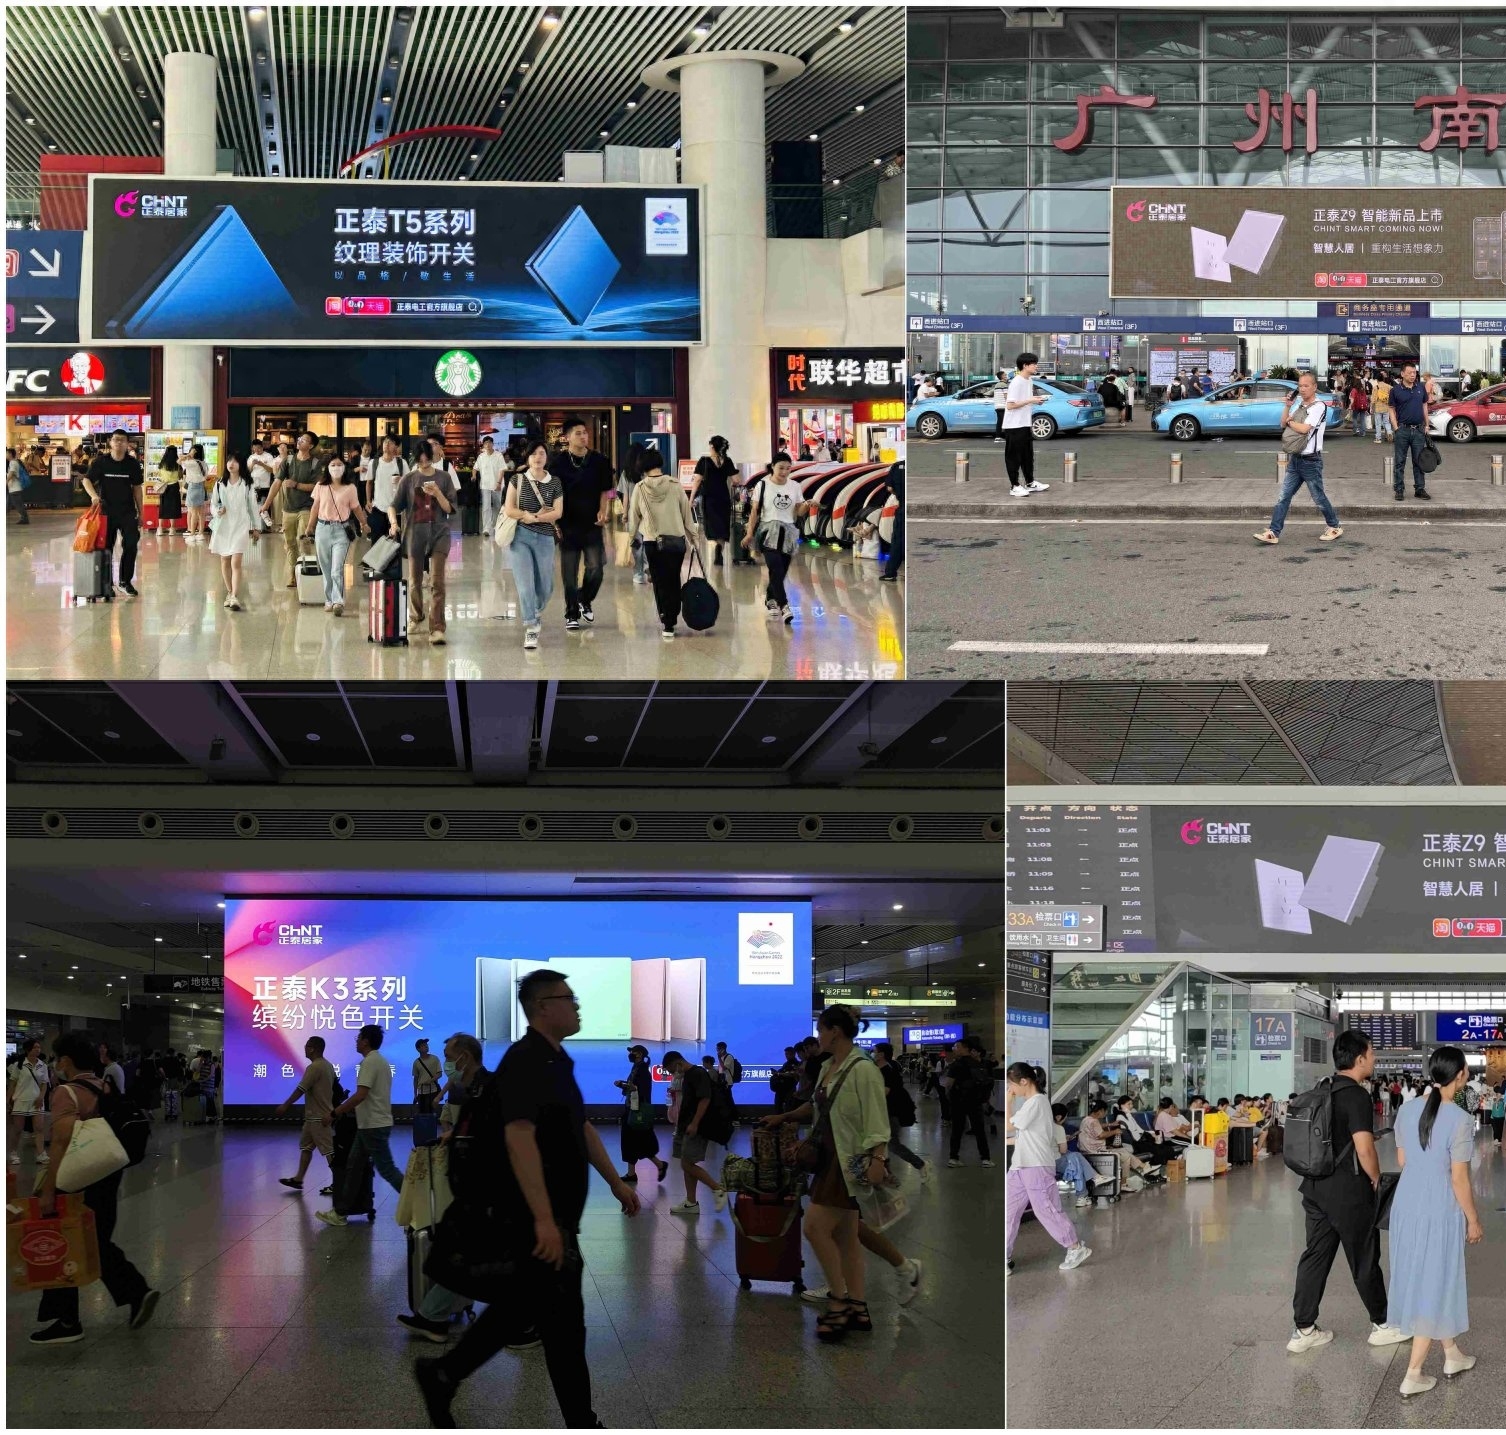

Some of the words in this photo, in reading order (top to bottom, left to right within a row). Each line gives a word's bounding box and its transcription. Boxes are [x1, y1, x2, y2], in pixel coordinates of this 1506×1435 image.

[142, 207, 188, 217] 正泰居家
[1148, 213, 1187, 221] 正泰居家
[1313, 208, 1357, 222] 正泰Z9
[1362, 208, 1444, 222] 智能新品上市
[334, 207, 476, 235] 正泰T5系列
[1313, 225, 1342, 233] CHINT
[1344, 225, 1376, 233] SMART
[1379, 225, 1416, 233] COMING
[1418, 225, 1444, 233] NOW!
[334, 241, 476, 265] 纹理装饰开关
[1313, 242, 1355, 254] 智慧人居
[1371, 243, 1444, 254] 重构生活想象力
[1372, 276, 1427, 284] 正泰电工官方旗舰店
[396, 303, 463, 312] 正泰电工官方旗舰店
[1353, 303, 1411, 312] 商务座专用通道
[1125, 323, 1137, 331] (3F)
[1275, 324, 1287, 332] (3F)
[1389, 324, 1401, 332] (3F)
[787, 354, 806, 391] 时代
[809, 358, 906, 387] 联华超市
[6, 369, 50, 392] FC
[1207, 834, 1252, 844] 正泰居家
[1422, 833, 1486, 853] 正泰Z9
[1423, 857, 1463, 868] CHINT
[1423, 881, 1484, 897] 智慧人居
[1008, 912, 1035, 926] 33A
[1035, 911, 1062, 922] 检票口
[1476, 922, 1496, 933] 天猫
[278, 936, 323, 945] 正泰居家
[253, 975, 407, 1001] 正泰K3系列
[252, 1004, 424, 1031] 缤纷悦色开关
[1007, 1013, 1043, 1025] 能分布示意图
[1256, 1017, 1286, 1033] 17A
[1461, 1029, 1503, 1039] 2A-17A
[253, 1064, 295, 1078] 潮色
[741, 1069, 773, 1078] 方旗舰店
